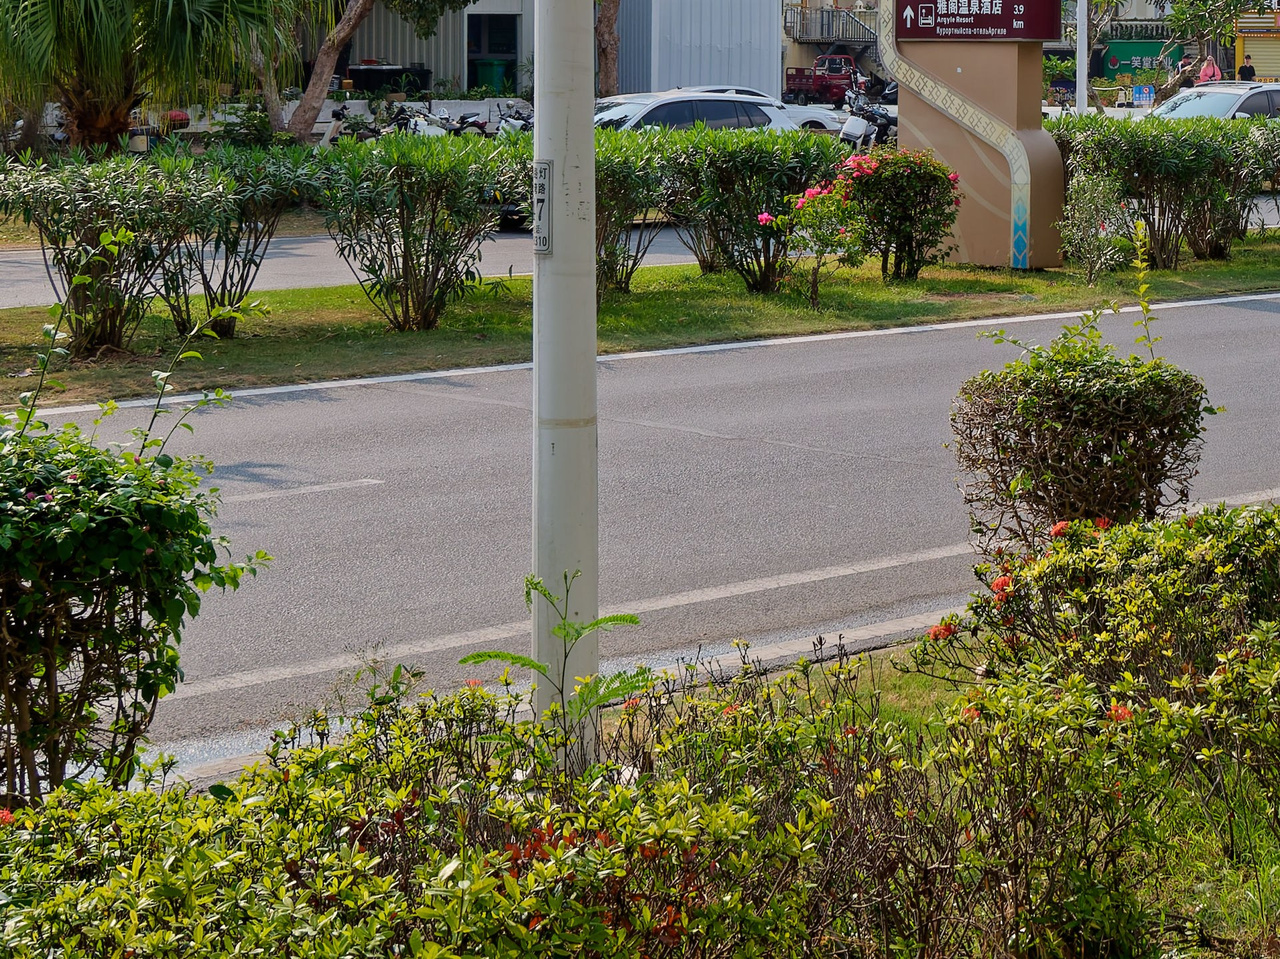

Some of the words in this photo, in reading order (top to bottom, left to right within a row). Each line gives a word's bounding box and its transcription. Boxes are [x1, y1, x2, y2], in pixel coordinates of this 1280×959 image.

[1014, 5, 1024, 15] 3.9
[936, 16, 955, 25] Argyle
[1013, 19, 1024, 28] km
